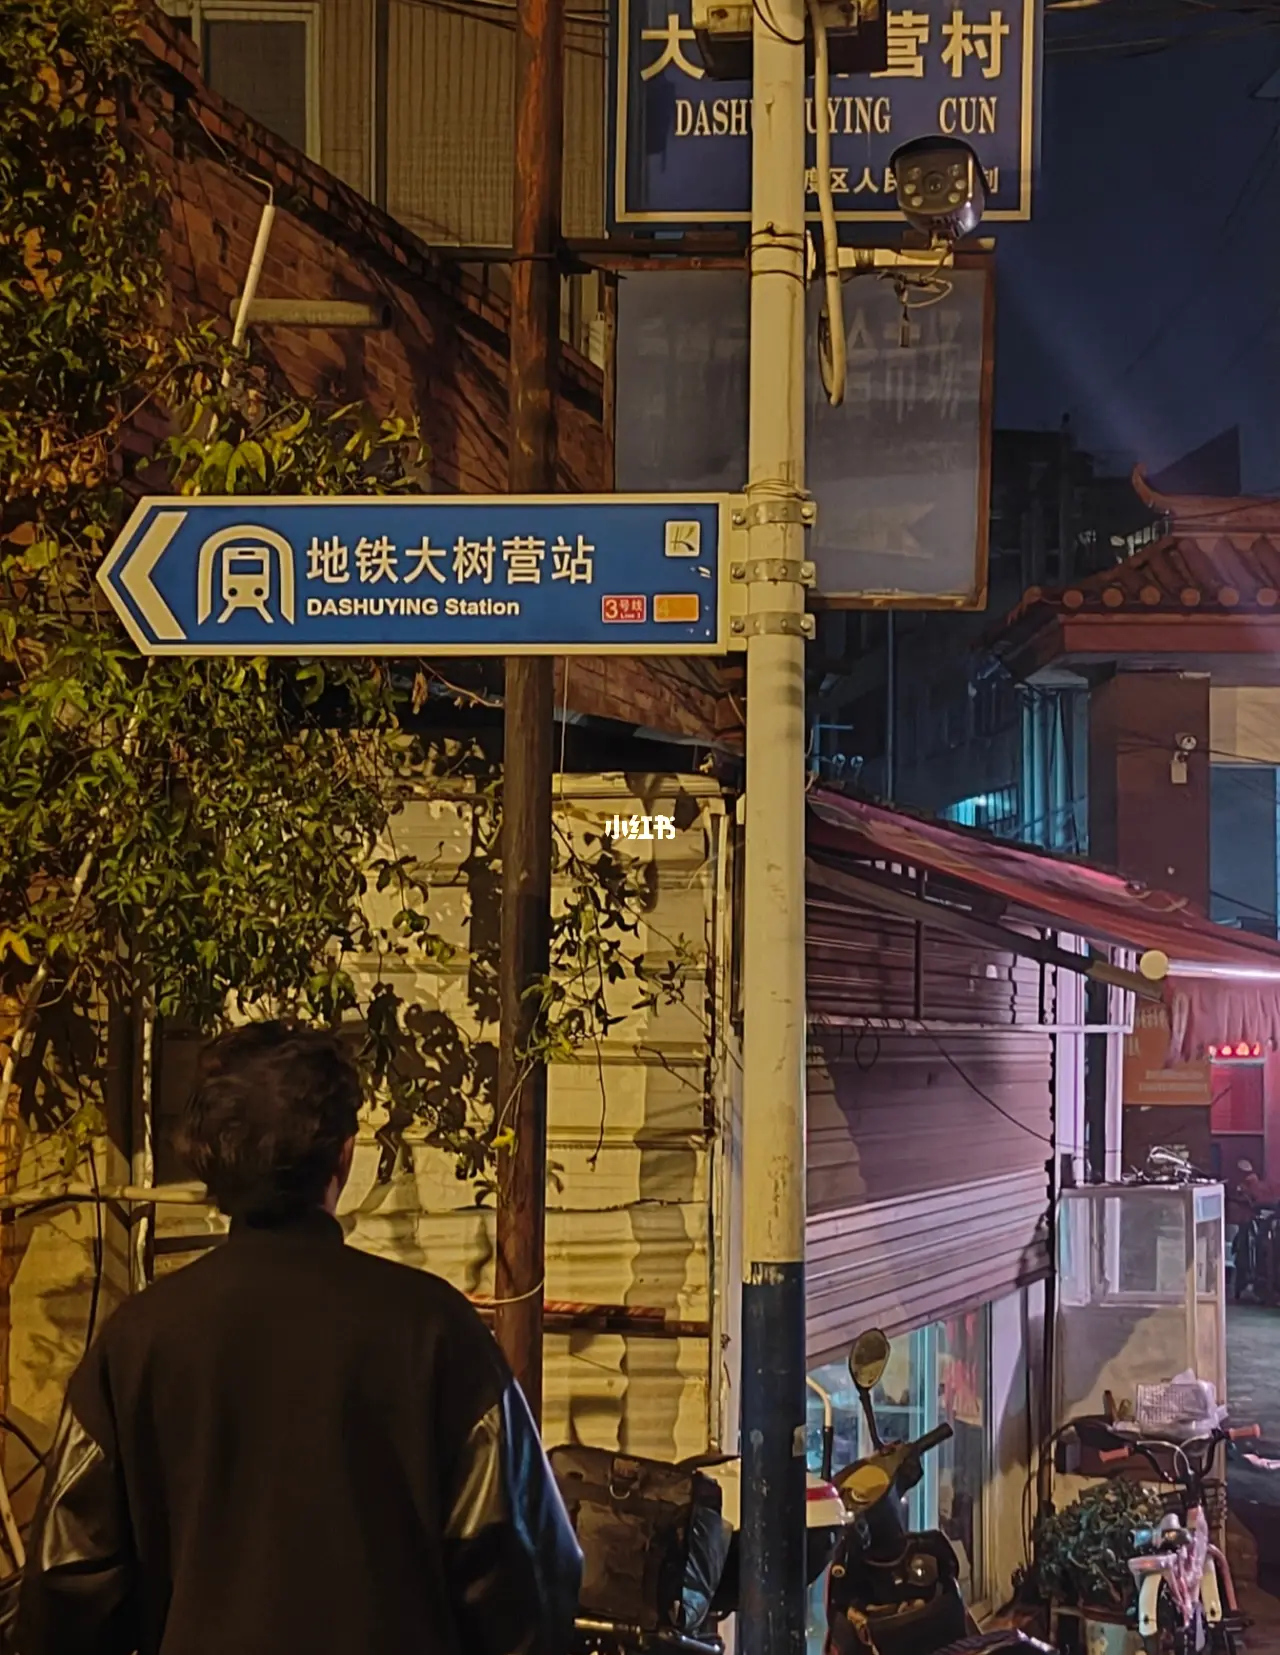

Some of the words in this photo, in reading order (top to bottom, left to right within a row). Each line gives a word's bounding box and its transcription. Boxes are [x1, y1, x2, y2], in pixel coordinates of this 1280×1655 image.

[939, 96, 998, 134] CUN
[307, 535, 596, 585] 地铁大树营站
[307, 598, 439, 616] DASHUYING
[445, 598, 520, 616] Station
